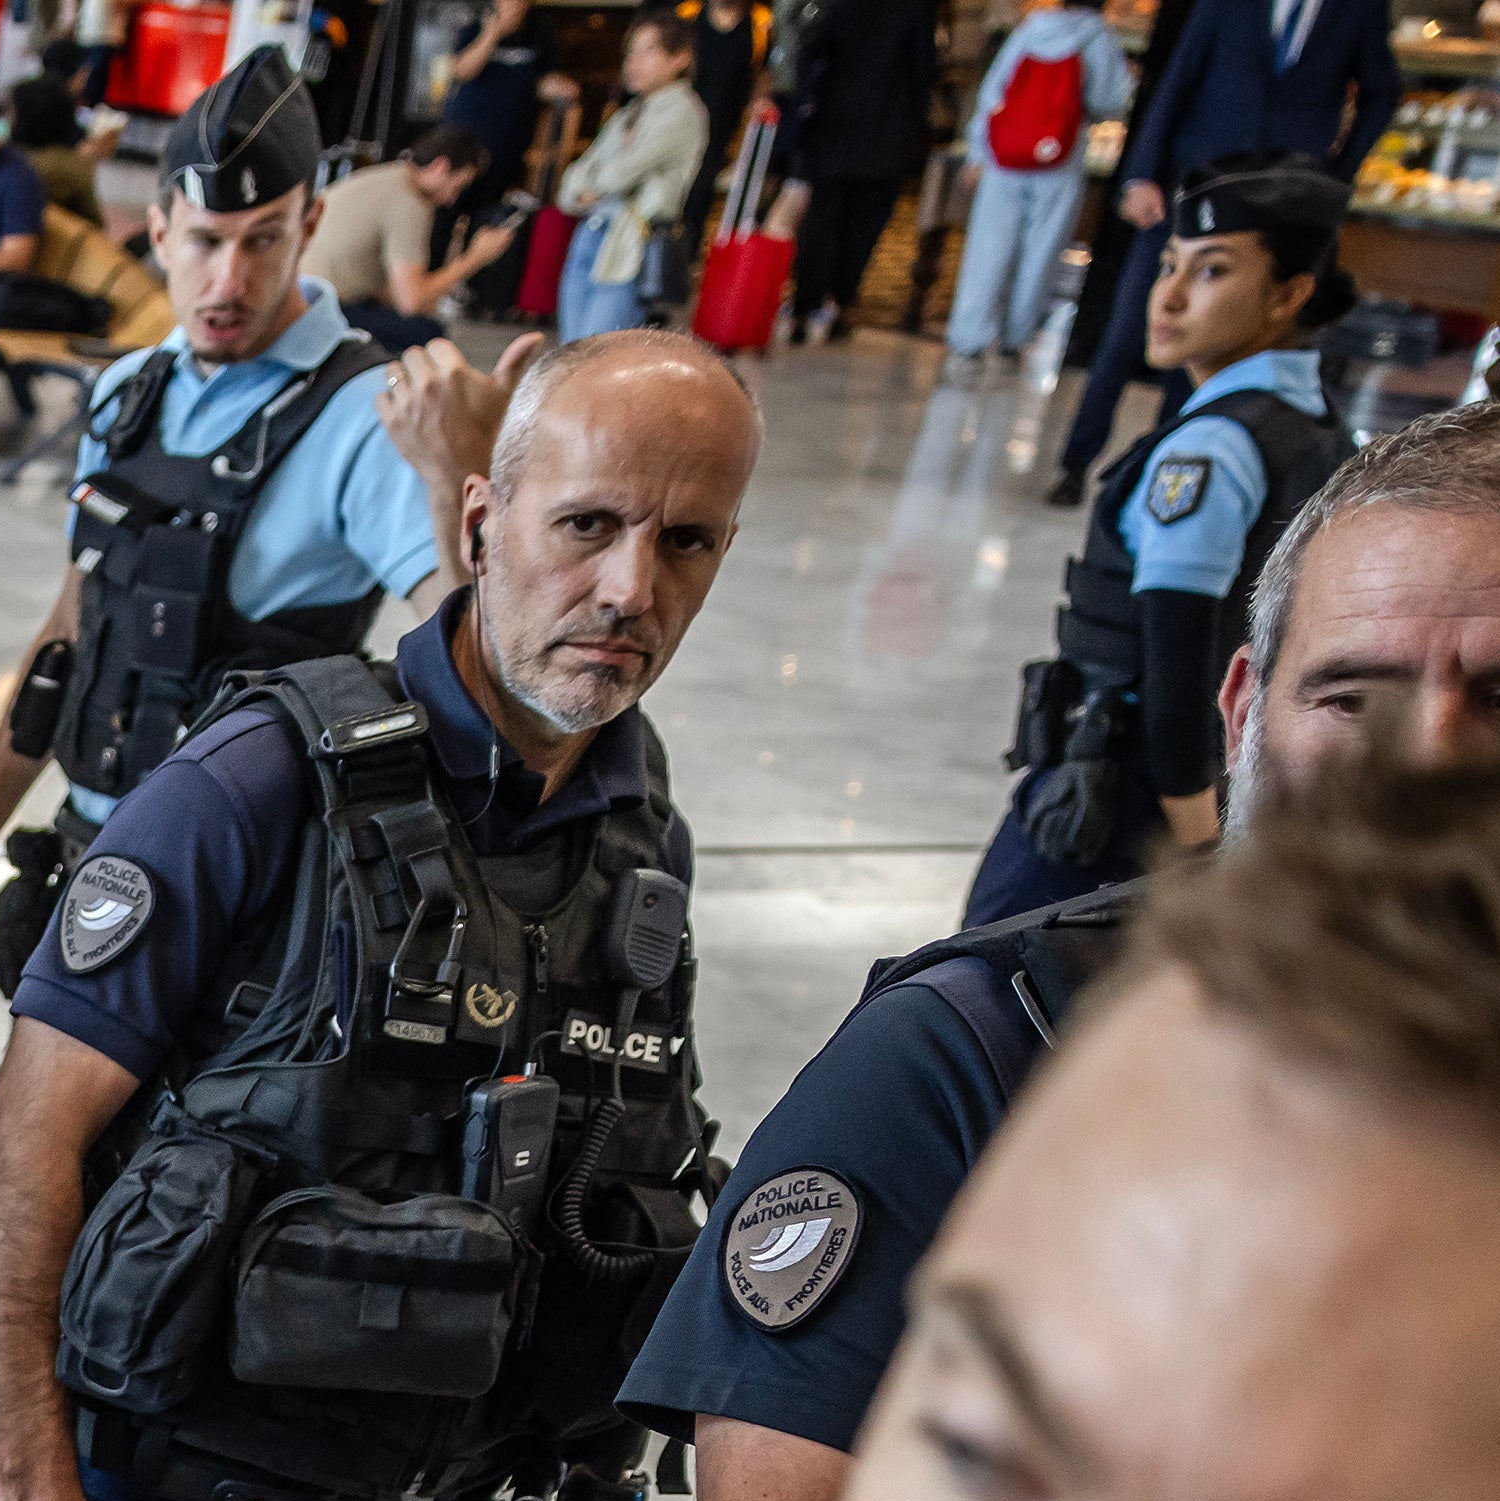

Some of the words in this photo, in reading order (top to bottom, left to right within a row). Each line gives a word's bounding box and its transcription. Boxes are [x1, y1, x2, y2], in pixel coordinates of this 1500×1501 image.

[98, 860, 141, 884] POLICE
[568, 1018, 663, 1063] POLCE
[738, 1192, 843, 1232] NATIONALE
[755, 1176, 824, 1207] POLICE
[730, 1250, 753, 1296] POLICE
[785, 1227, 847, 1312] FRONTIERES
